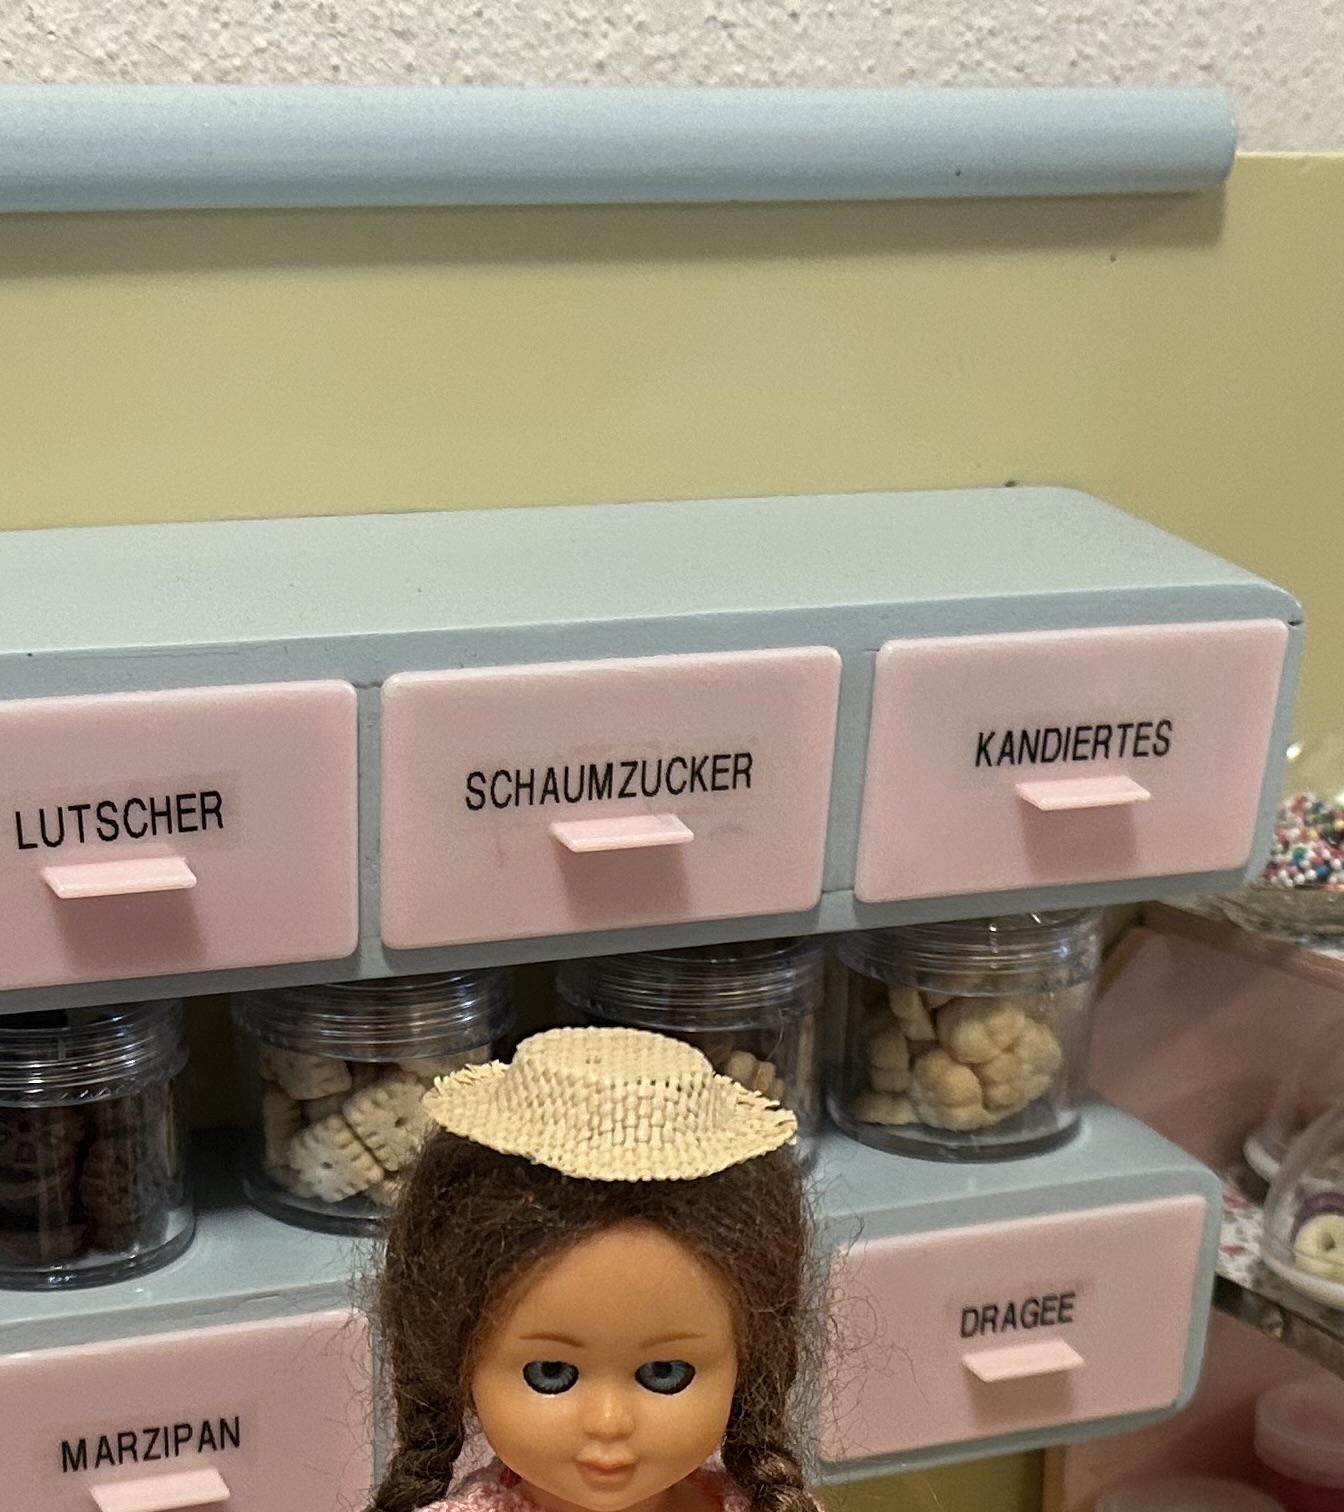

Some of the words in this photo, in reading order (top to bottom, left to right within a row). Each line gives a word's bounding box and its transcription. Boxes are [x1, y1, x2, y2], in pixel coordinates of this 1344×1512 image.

[974, 718, 1174, 767] KANDIERTES
[465, 752, 754, 811] SCHAUMZUCKER
[15, 790, 224, 849] LUTSCHER
[959, 1290, 1077, 1338] DRAGEE
[60, 1415, 241, 1473] MARZIPAN
